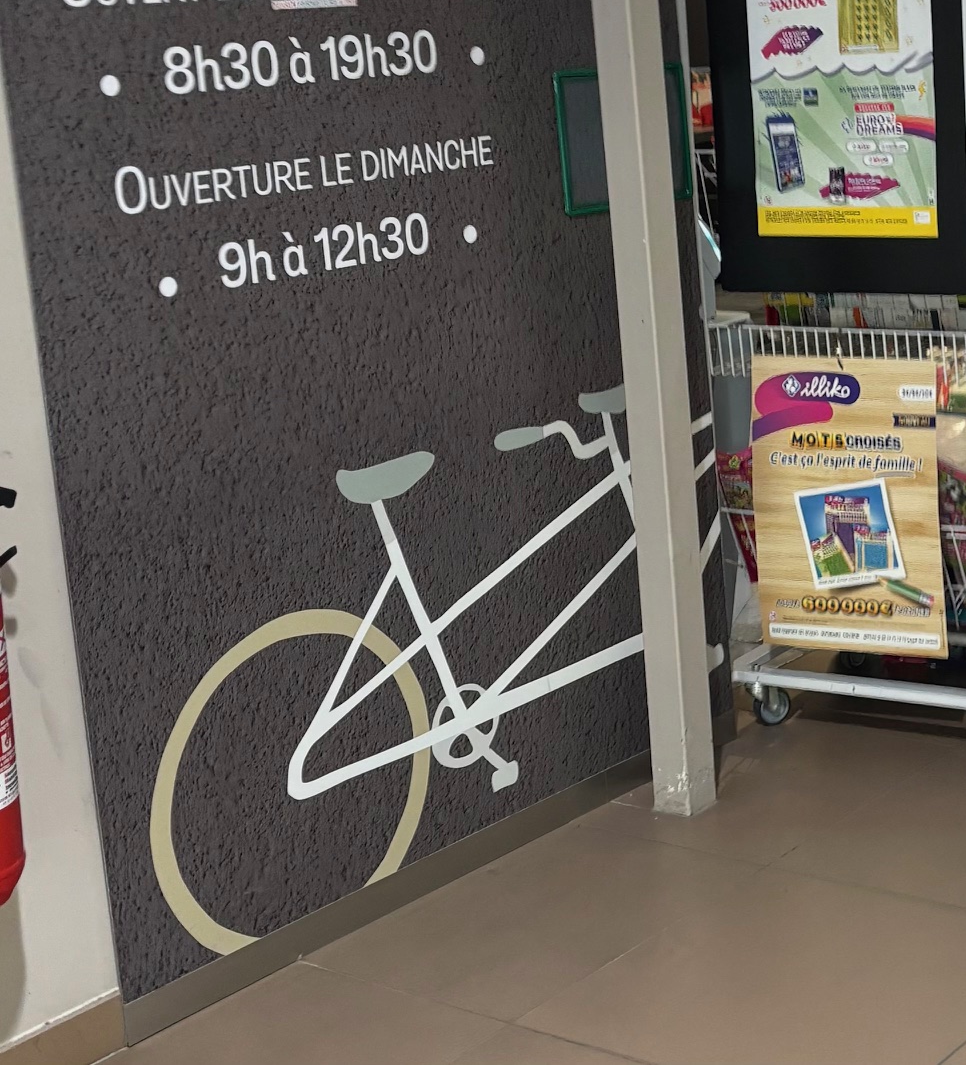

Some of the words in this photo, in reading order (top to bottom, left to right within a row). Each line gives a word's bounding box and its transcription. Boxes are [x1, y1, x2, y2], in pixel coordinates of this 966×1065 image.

[163, 40, 279, 94] 8h30
[289, 36, 315, 83] à
[320, 29, 437, 80] 19h30
[115, 157, 312, 214] OUVERTURE
[320, 153, 354, 187] LE
[361, 135, 494, 182] DIMANCHE
[219, 239, 276, 288] 9h
[283, 231, 308, 277] à
[314, 212, 429, 271] 12h30
[800, 375, 850, 398] illiko
[770, 452, 797, 465] C'est
[801, 455, 813, 468] ça
[816, 452, 855, 468] l'esprit
[859, 456, 871, 469] de
[873, 454, 915, 472] famille
[791, 431, 844, 448] MOTS
[846, 434, 902, 450] CROISÉS
